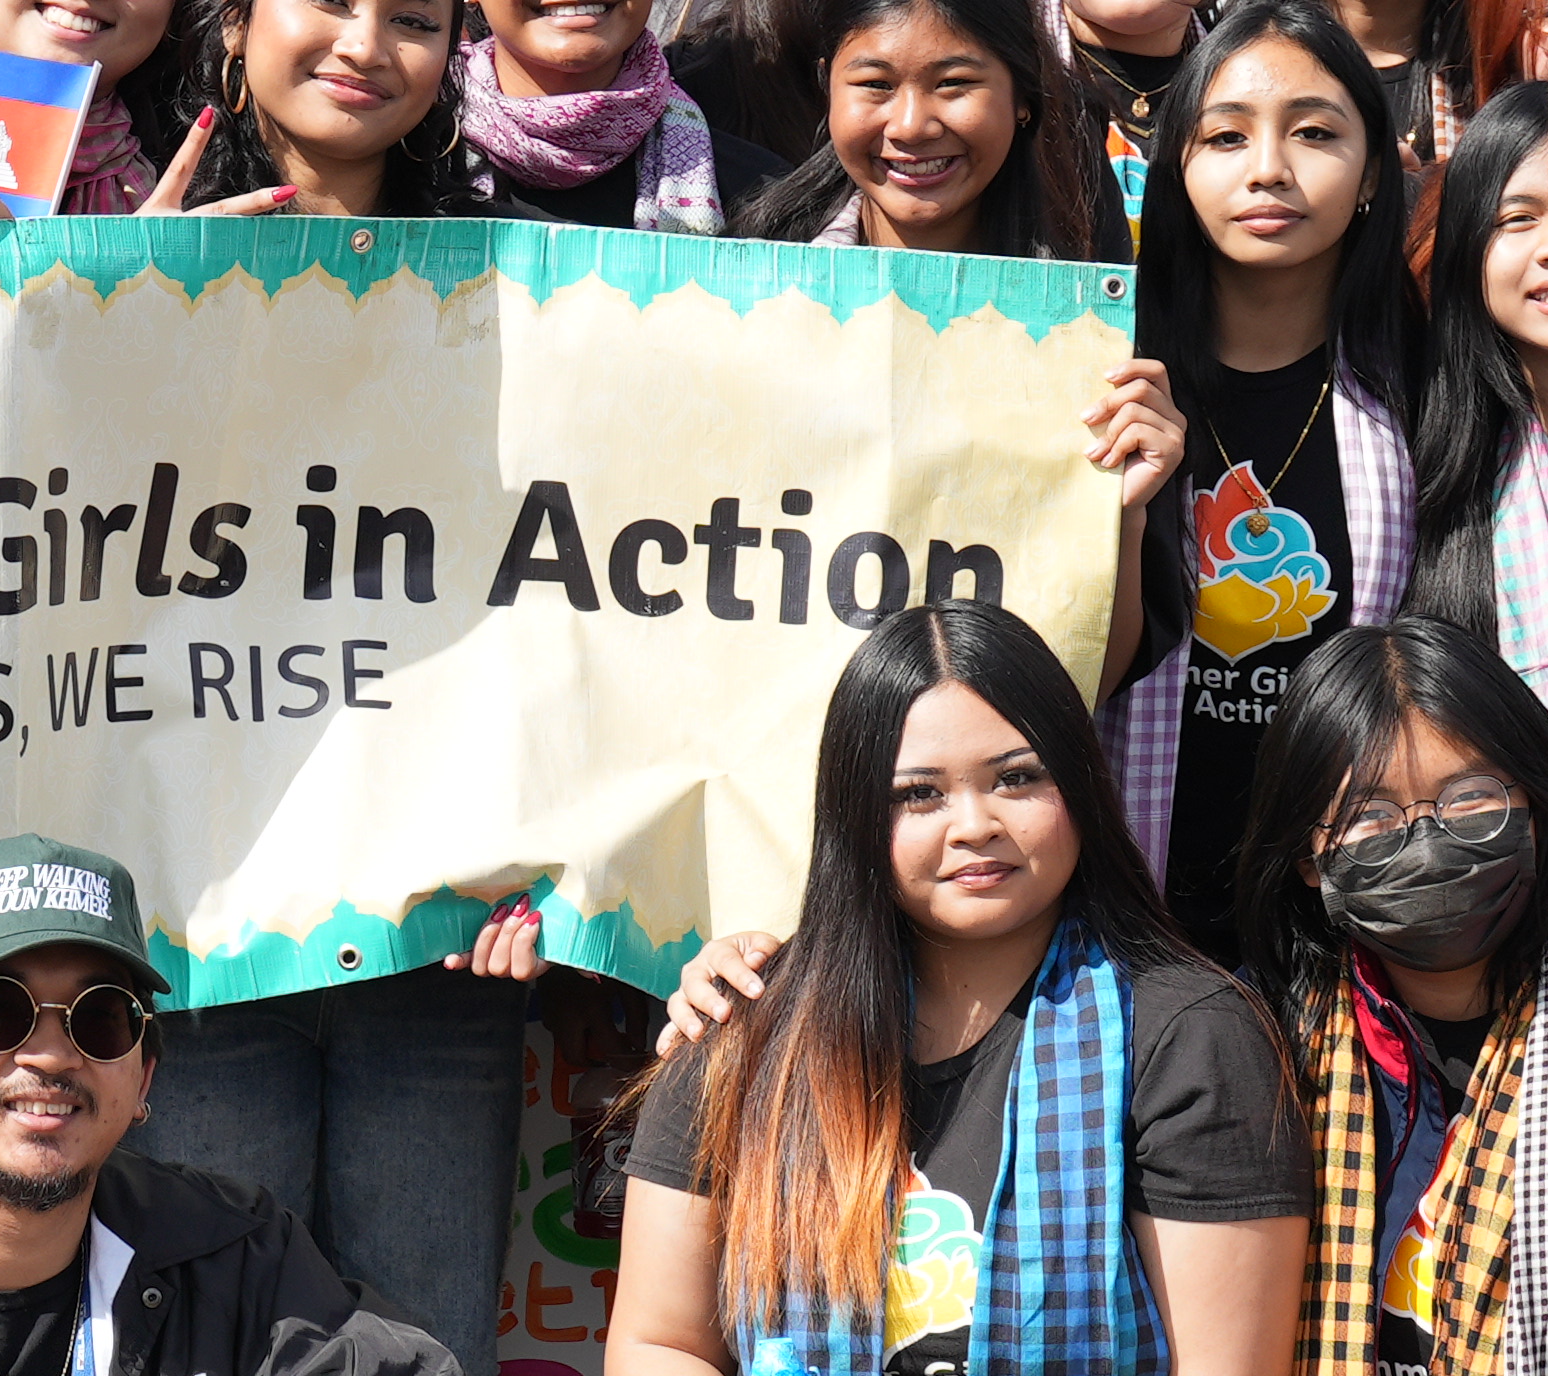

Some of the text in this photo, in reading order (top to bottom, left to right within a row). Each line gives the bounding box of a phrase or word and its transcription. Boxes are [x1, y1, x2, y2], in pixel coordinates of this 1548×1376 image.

[297, 464, 437, 604] in
[486, 480, 1005, 630] Action
[47, 644, 154, 732] WE
[188, 639, 388, 722] RISE
